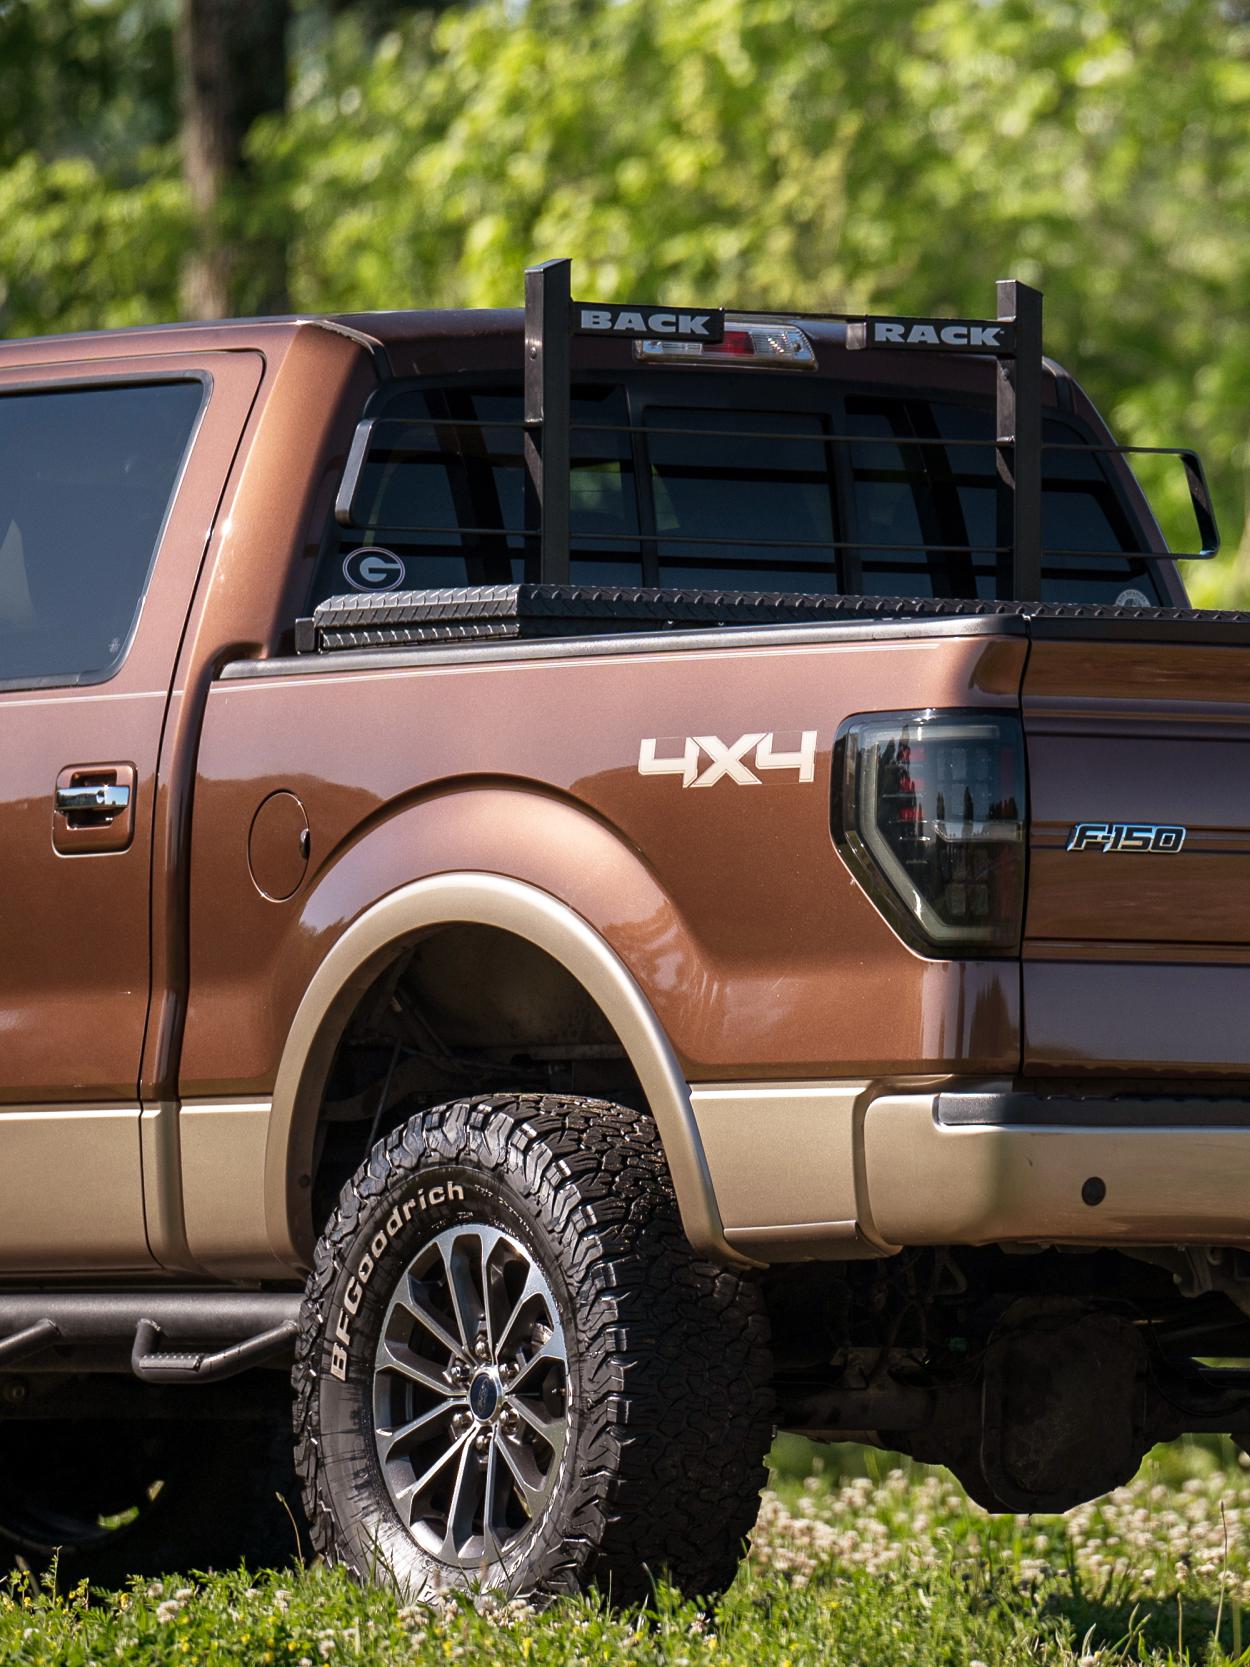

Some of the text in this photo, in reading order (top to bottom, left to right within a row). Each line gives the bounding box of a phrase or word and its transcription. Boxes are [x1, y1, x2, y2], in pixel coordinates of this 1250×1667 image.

[580, 309, 1002, 346] BACK RACK
[1066, 821, 1187, 854] F-150
[330, 1181, 465, 1382] BFGoodrich
